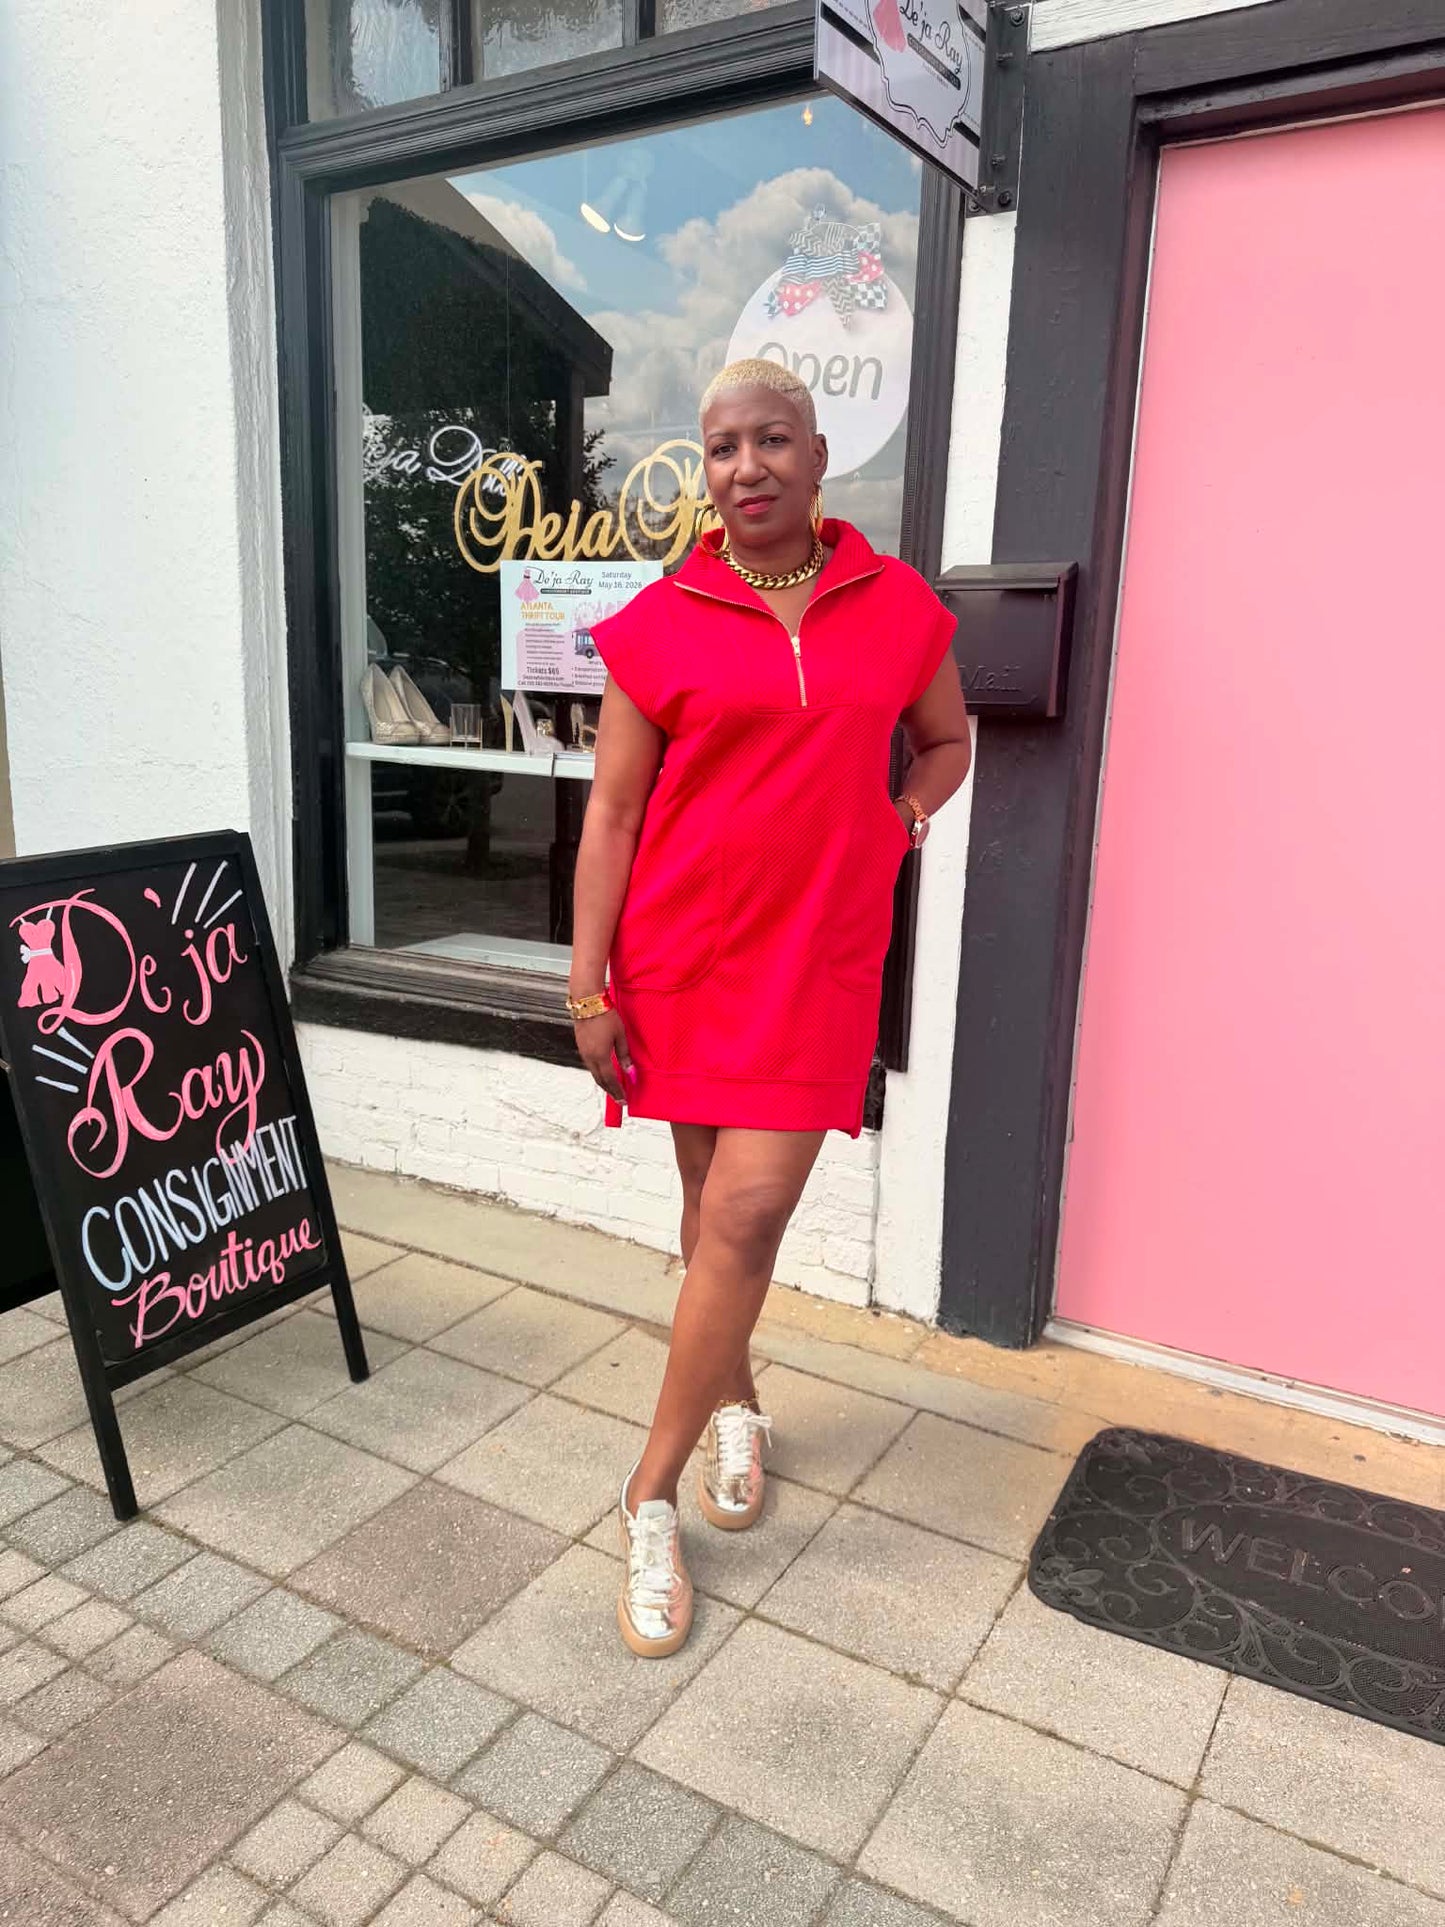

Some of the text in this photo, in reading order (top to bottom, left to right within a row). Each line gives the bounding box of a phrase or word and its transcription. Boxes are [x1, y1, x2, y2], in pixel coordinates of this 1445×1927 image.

[934, 20, 963, 75] Ray
[565, 569, 594, 588] Ray
[601, 571, 632, 580] Saturday
[598, 581, 612, 590] May
[520, 602, 553, 610] ATLANTA
[521, 611, 565, 620] THRIFT TOUR
[526, 666, 547, 675] Tickets
[67, 1026, 267, 1179] Ray
[81, 1114, 310, 1292] CONSIGNMENT
[110, 1216, 323, 1349] Boutique
[1182, 1519, 1445, 1625] WELCO
